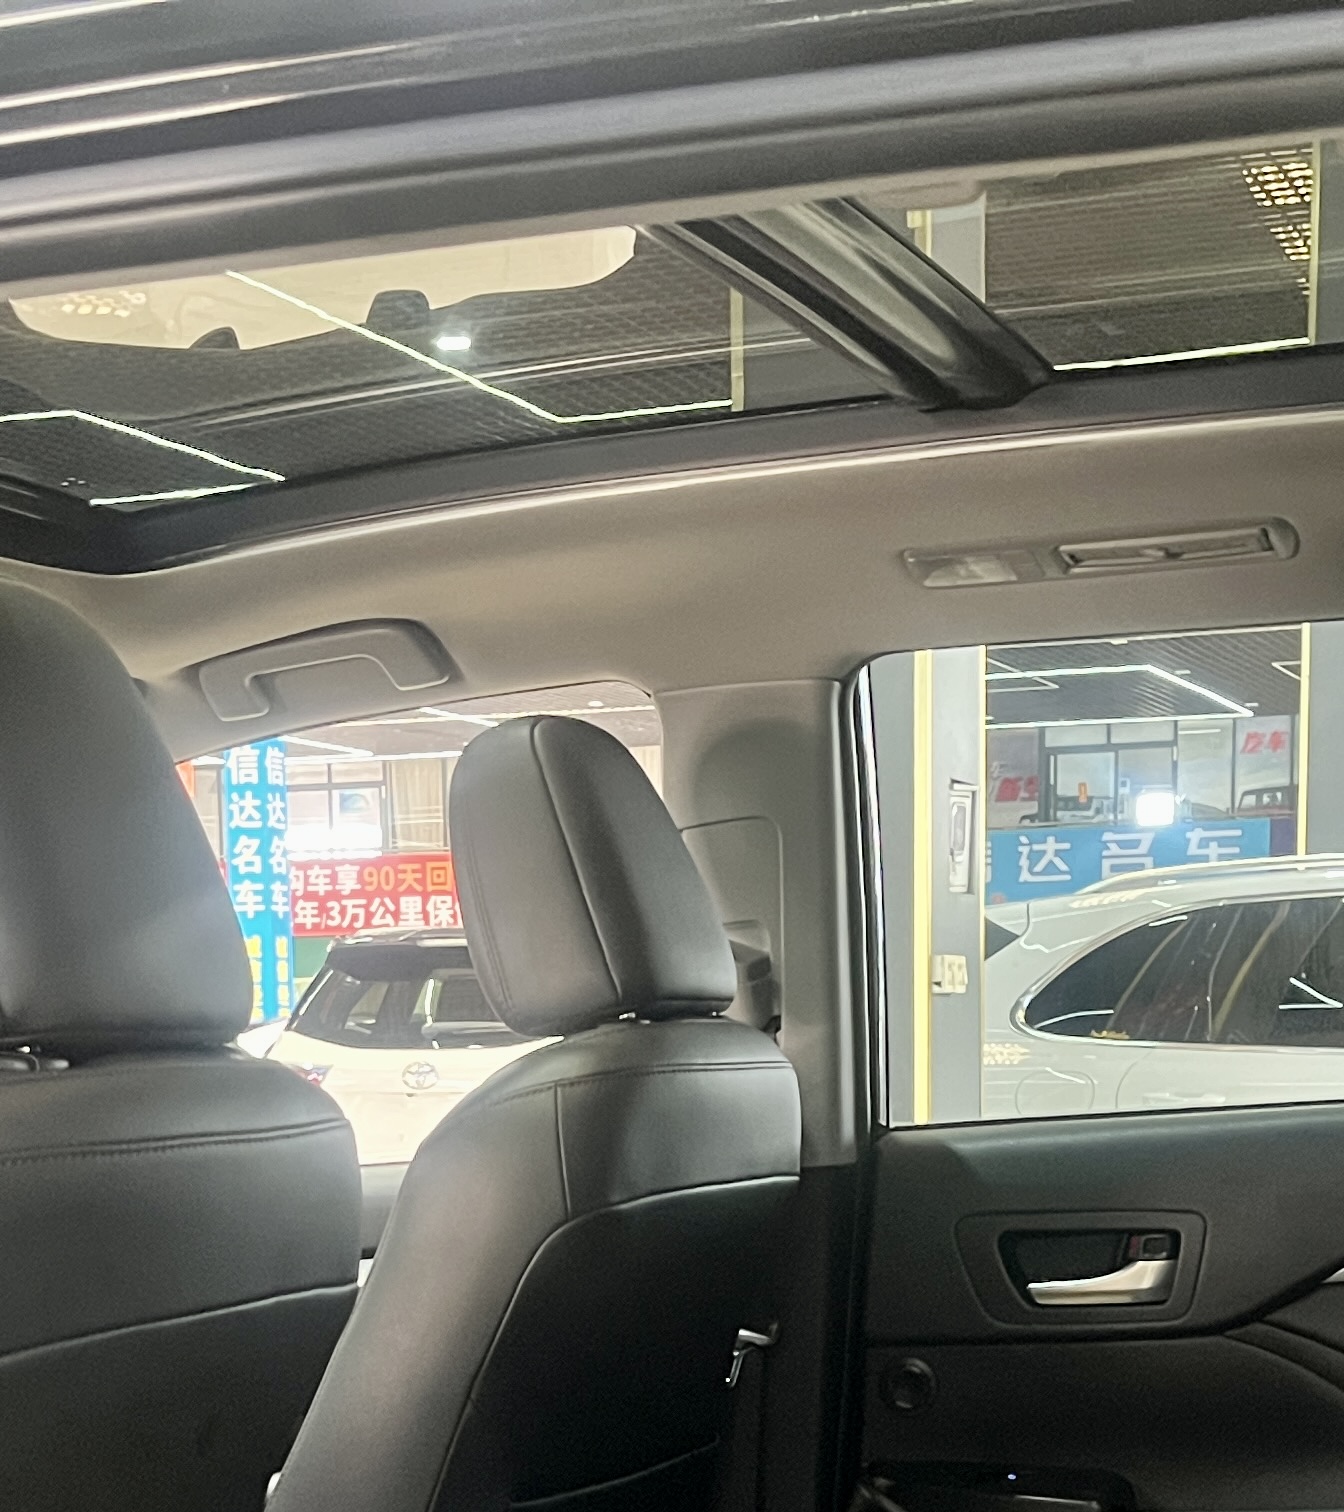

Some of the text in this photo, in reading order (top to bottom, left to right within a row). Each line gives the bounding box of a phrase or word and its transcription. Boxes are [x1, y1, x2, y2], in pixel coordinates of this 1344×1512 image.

[227, 747, 266, 918] 信达名车
[264, 746, 290, 919] 信达名车
